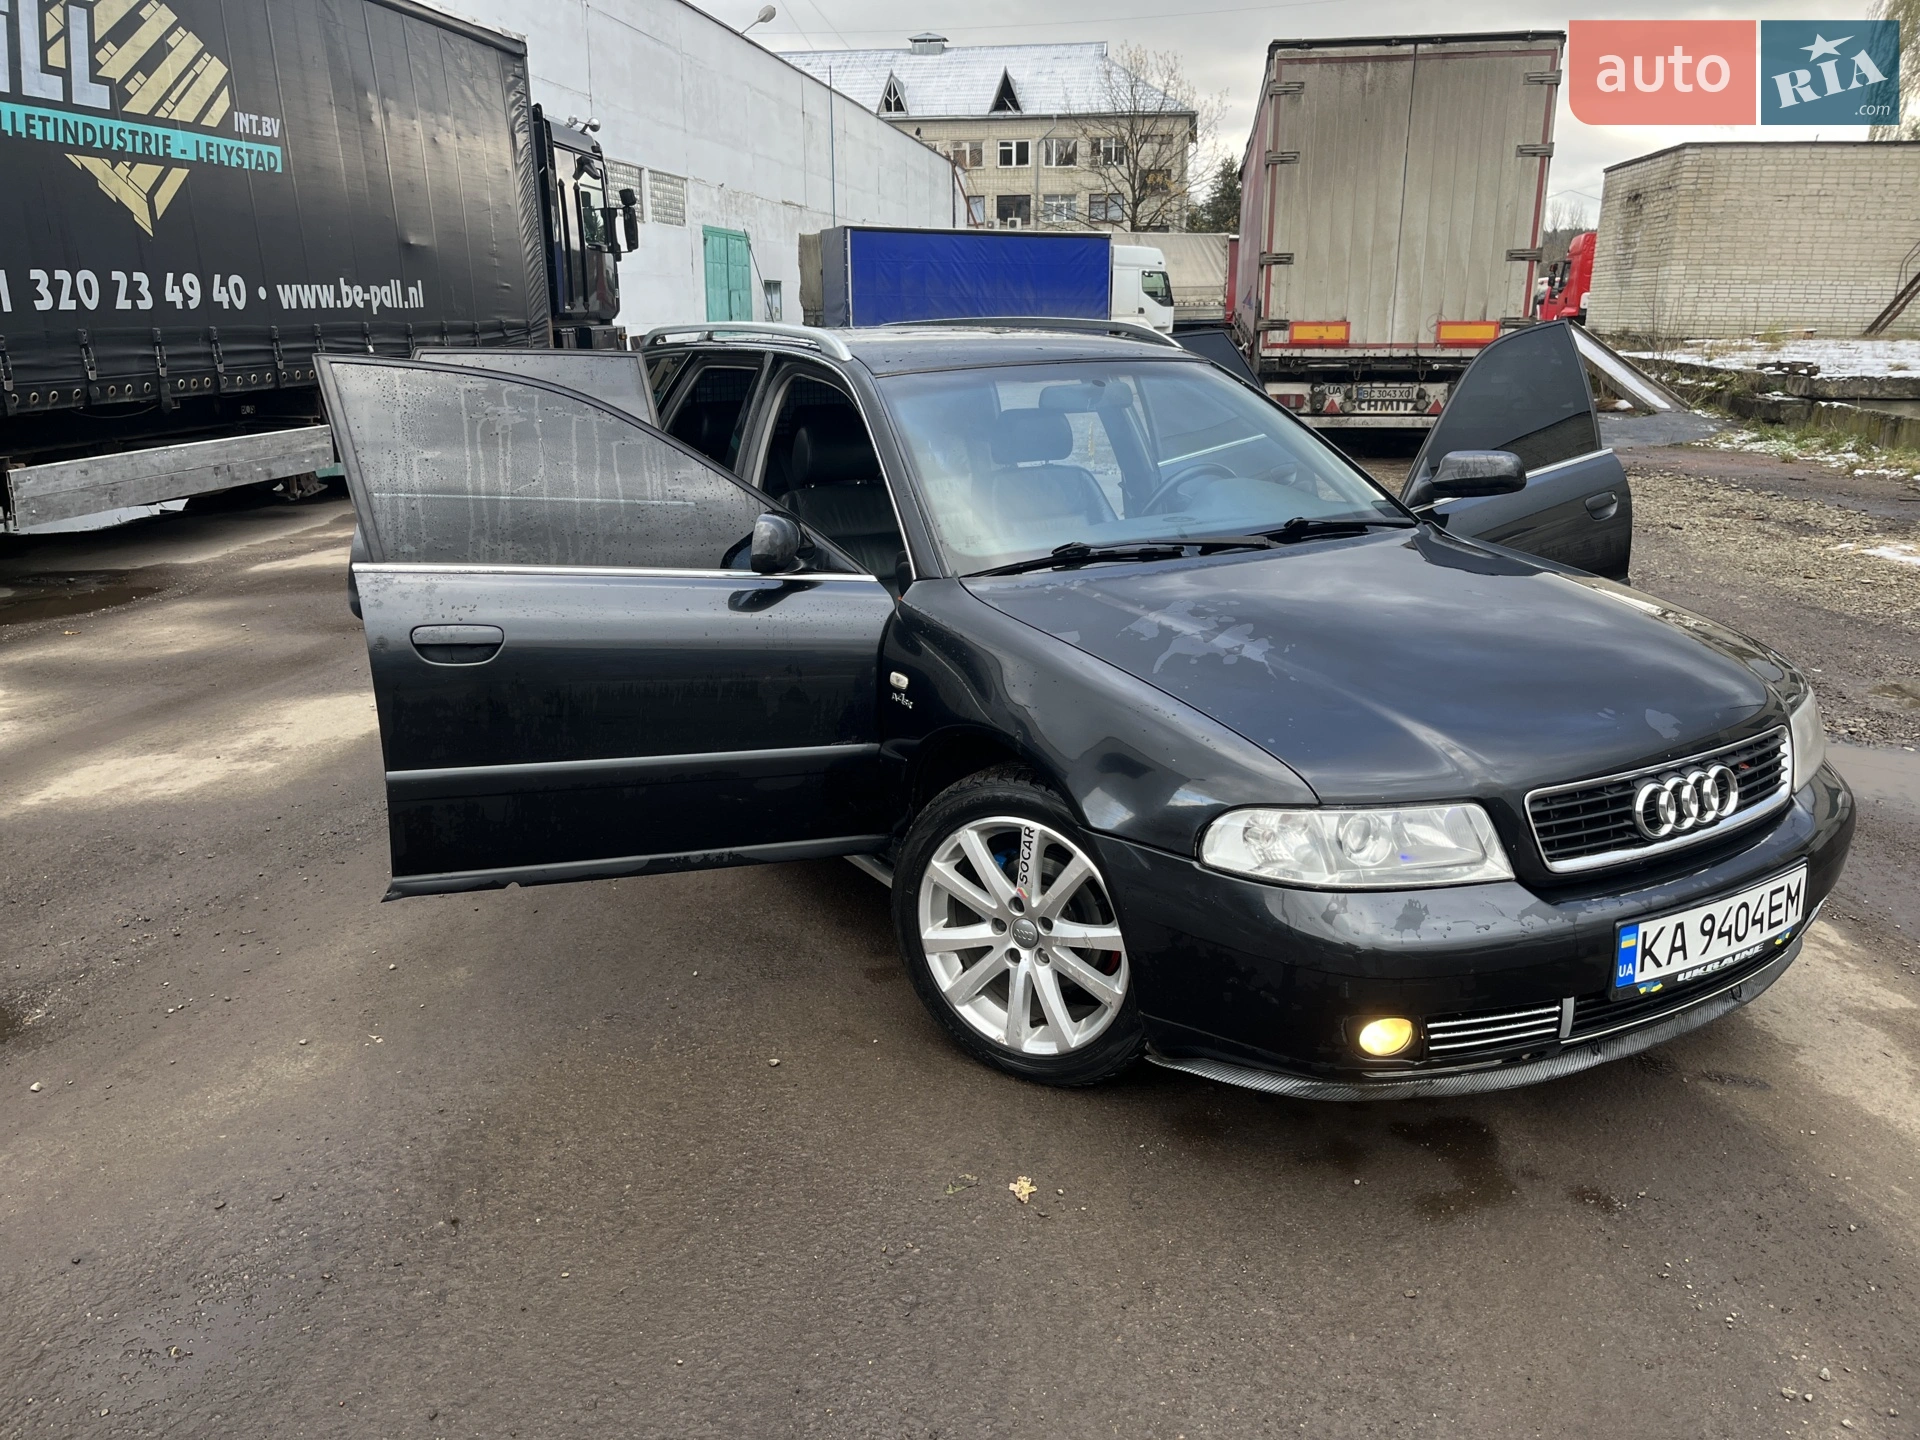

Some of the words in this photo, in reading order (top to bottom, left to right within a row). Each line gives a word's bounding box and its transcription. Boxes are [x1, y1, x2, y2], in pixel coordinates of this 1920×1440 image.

[0, 0, 110, 110] LL
[234, 111, 281, 138] INT.BV
[196, 139, 278, 172] LELYSTAD
[30, 269, 99, 311] 320
[111, 270, 154, 310] 23
[165, 272, 201, 310] 49
[213, 274, 246, 310] 40
[276, 277, 424, 315] www.be-pall.nl
[1327, 386, 1342, 395] UA
[1362, 390, 1376, 398] BC
[1377, 390, 1397, 399] 3043
[1020, 826, 1035, 885] SOCAR
[1639, 921, 1688, 973] KA
[1677, 942, 1764, 982] UKRAINE
[1618, 963, 1634, 978] UA
